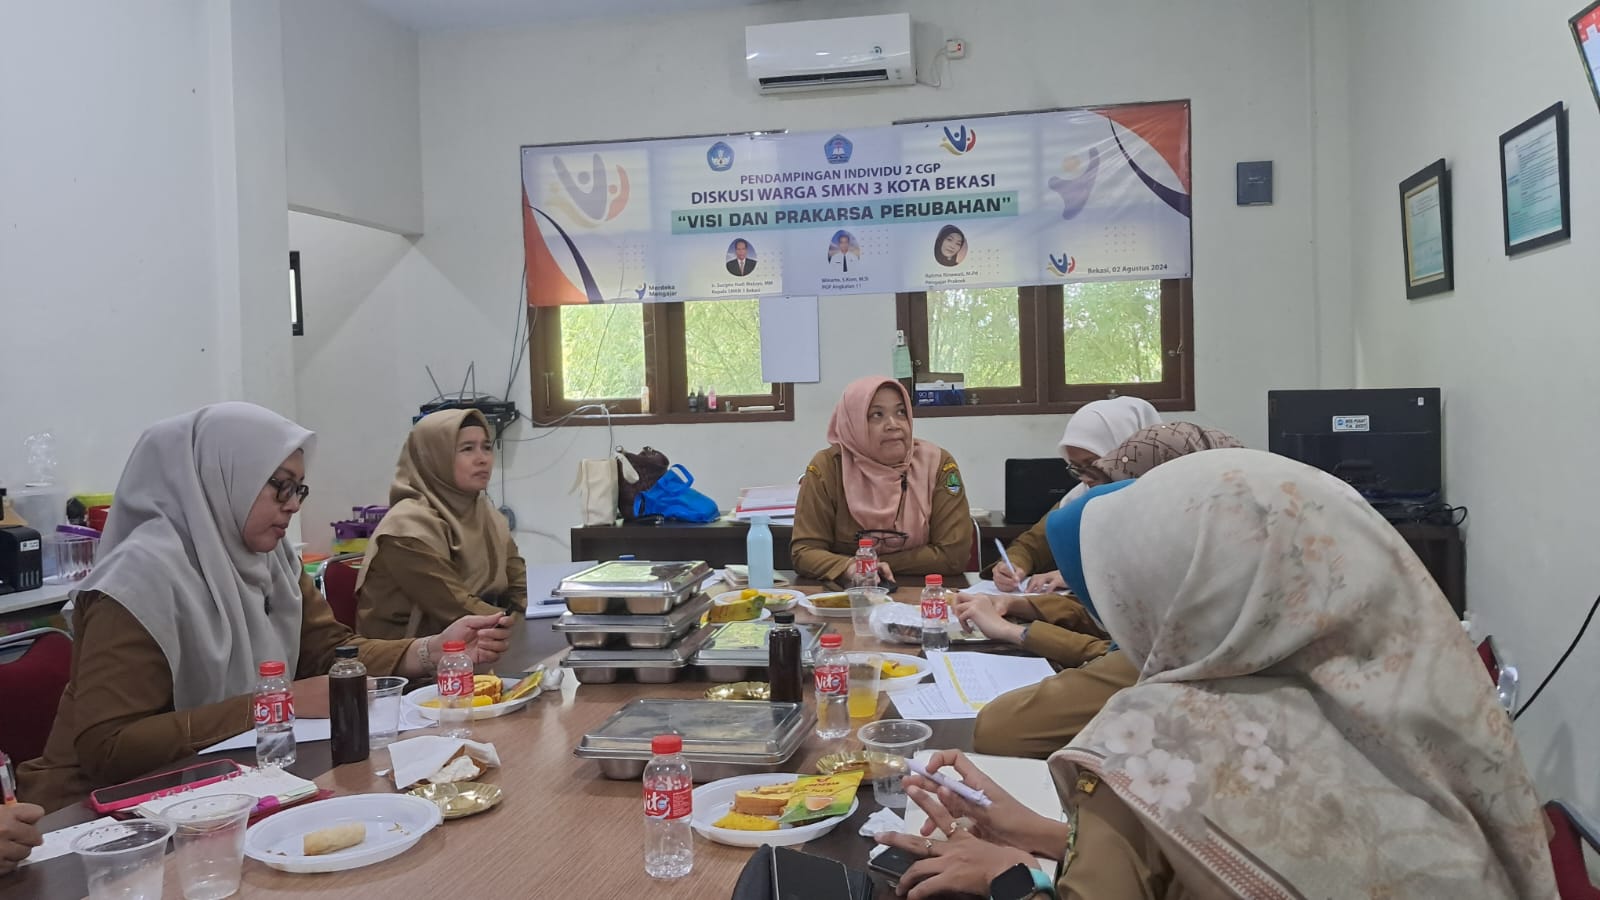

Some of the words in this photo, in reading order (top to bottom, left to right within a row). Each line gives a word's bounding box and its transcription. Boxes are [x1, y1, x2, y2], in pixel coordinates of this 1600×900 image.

[740, 169, 841, 185] PENDAMPINGAN
[844, 165, 902, 179] INDIVIDU
[905, 165, 912, 175] 2
[915, 163, 941, 174] CGP
[691, 189, 754, 205] DISKUSI
[758, 185, 817, 201] WARGA
[821, 182, 869, 198] SMKN
[873, 182, 882, 194] 3
[887, 178, 931, 194] KOTA
[935, 173, 996, 191] BEKASI
[729, 211, 768, 227] DAN
[775, 205, 874, 224] PRAKARSA
[1122, 265, 1149, 273] Agustus
